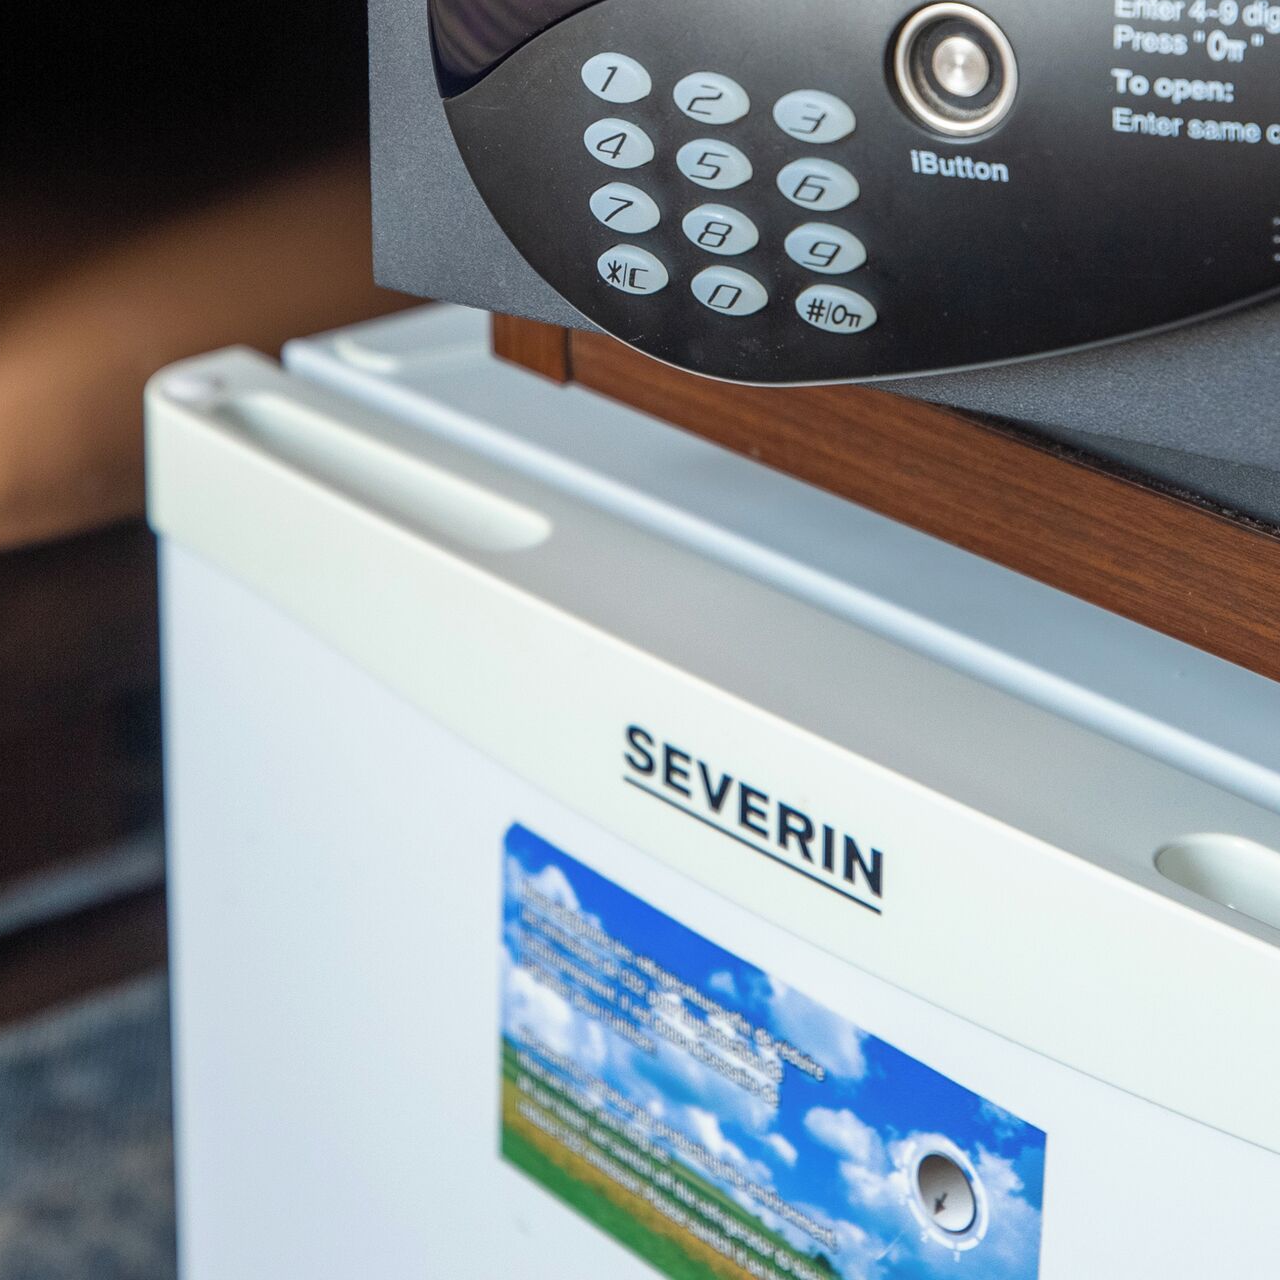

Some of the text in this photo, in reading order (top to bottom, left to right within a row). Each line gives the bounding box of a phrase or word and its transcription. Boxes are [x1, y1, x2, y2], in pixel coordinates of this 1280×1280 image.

[1113, 24, 1188, 55] Press
[599, 66, 827, 135] 1 2 3
[1111, 68, 1235, 105] To open:
[1112, 106, 1184, 137] Enter
[1187, 118, 1262, 144] same
[596, 131, 833, 203] 4 5 6
[910, 149, 1009, 182] iButton
[603, 195, 842, 268] 7 8 9
[623, 723, 883, 899] SEVERIN
